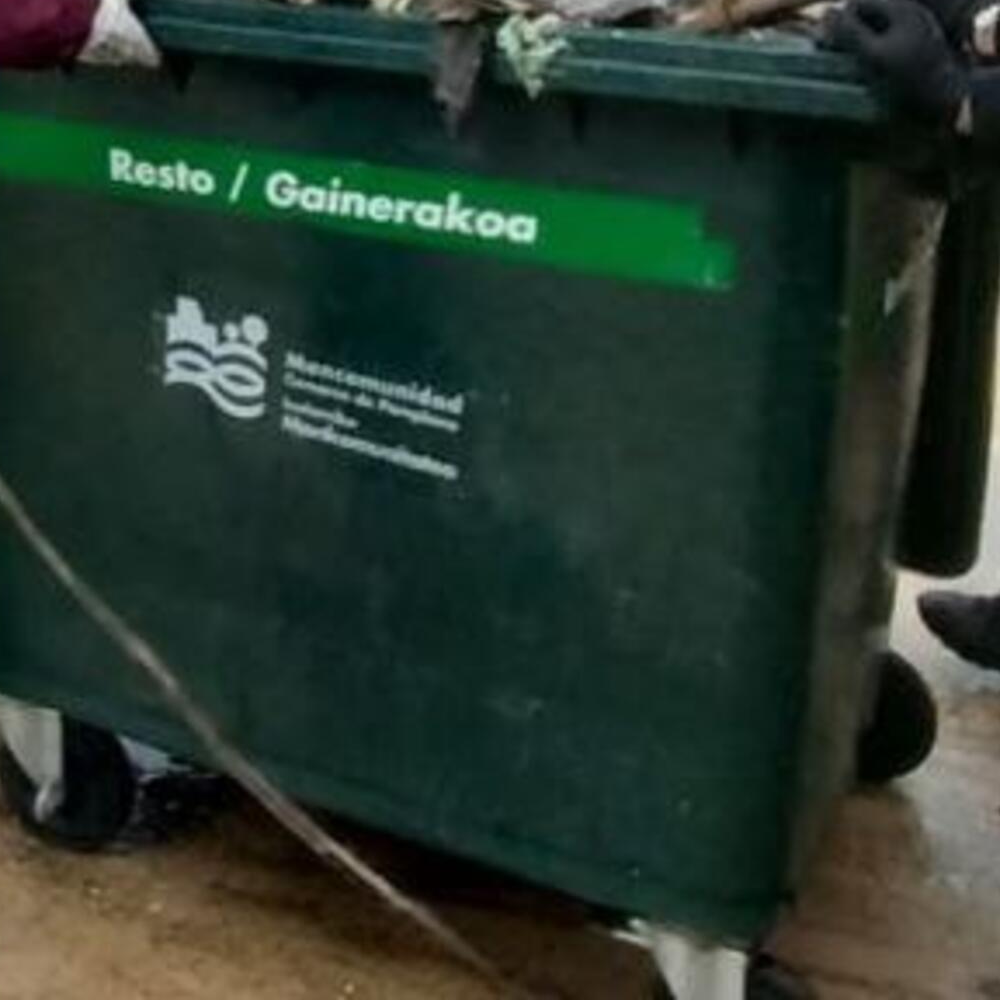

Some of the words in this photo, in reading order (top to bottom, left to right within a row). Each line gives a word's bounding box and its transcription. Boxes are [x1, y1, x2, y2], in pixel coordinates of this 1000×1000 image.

[109, 147, 216, 196] Resto
[229, 162, 250, 202] /
[264, 170, 539, 244] Gainerakoa
